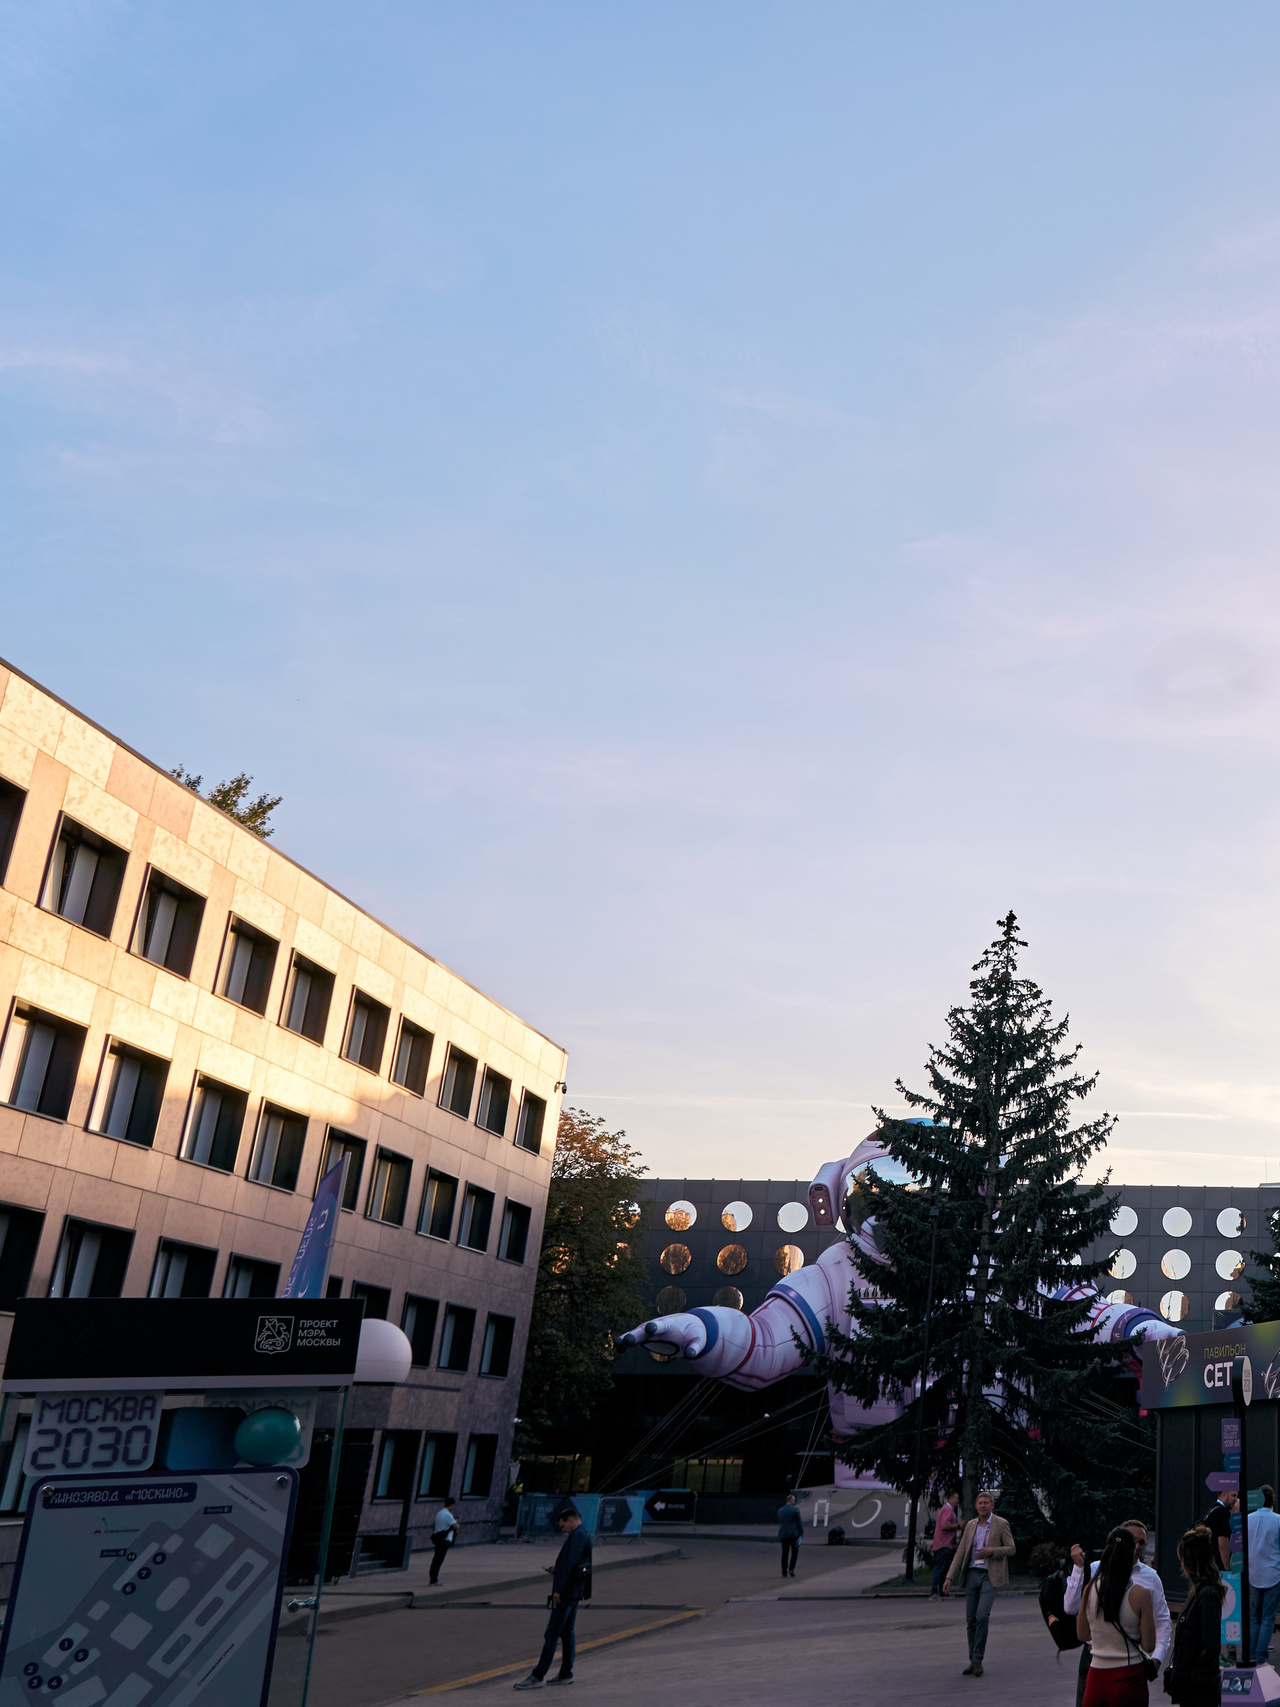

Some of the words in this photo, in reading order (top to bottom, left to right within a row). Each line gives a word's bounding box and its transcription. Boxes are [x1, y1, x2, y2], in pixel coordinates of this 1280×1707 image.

[299, 1319, 339, 1328] ПРОЕКТ
[297, 1329, 327, 1337] МЭРА
[296, 1338, 342, 1347] МОСКВЫ
[1203, 1343, 1246, 1359] ПАВИЛЬОН
[38, 1395, 157, 1424] МОСКВА
[31, 1425, 152, 1469] 2030
[50, 1492, 119, 1504] КИНОЗАВОД
